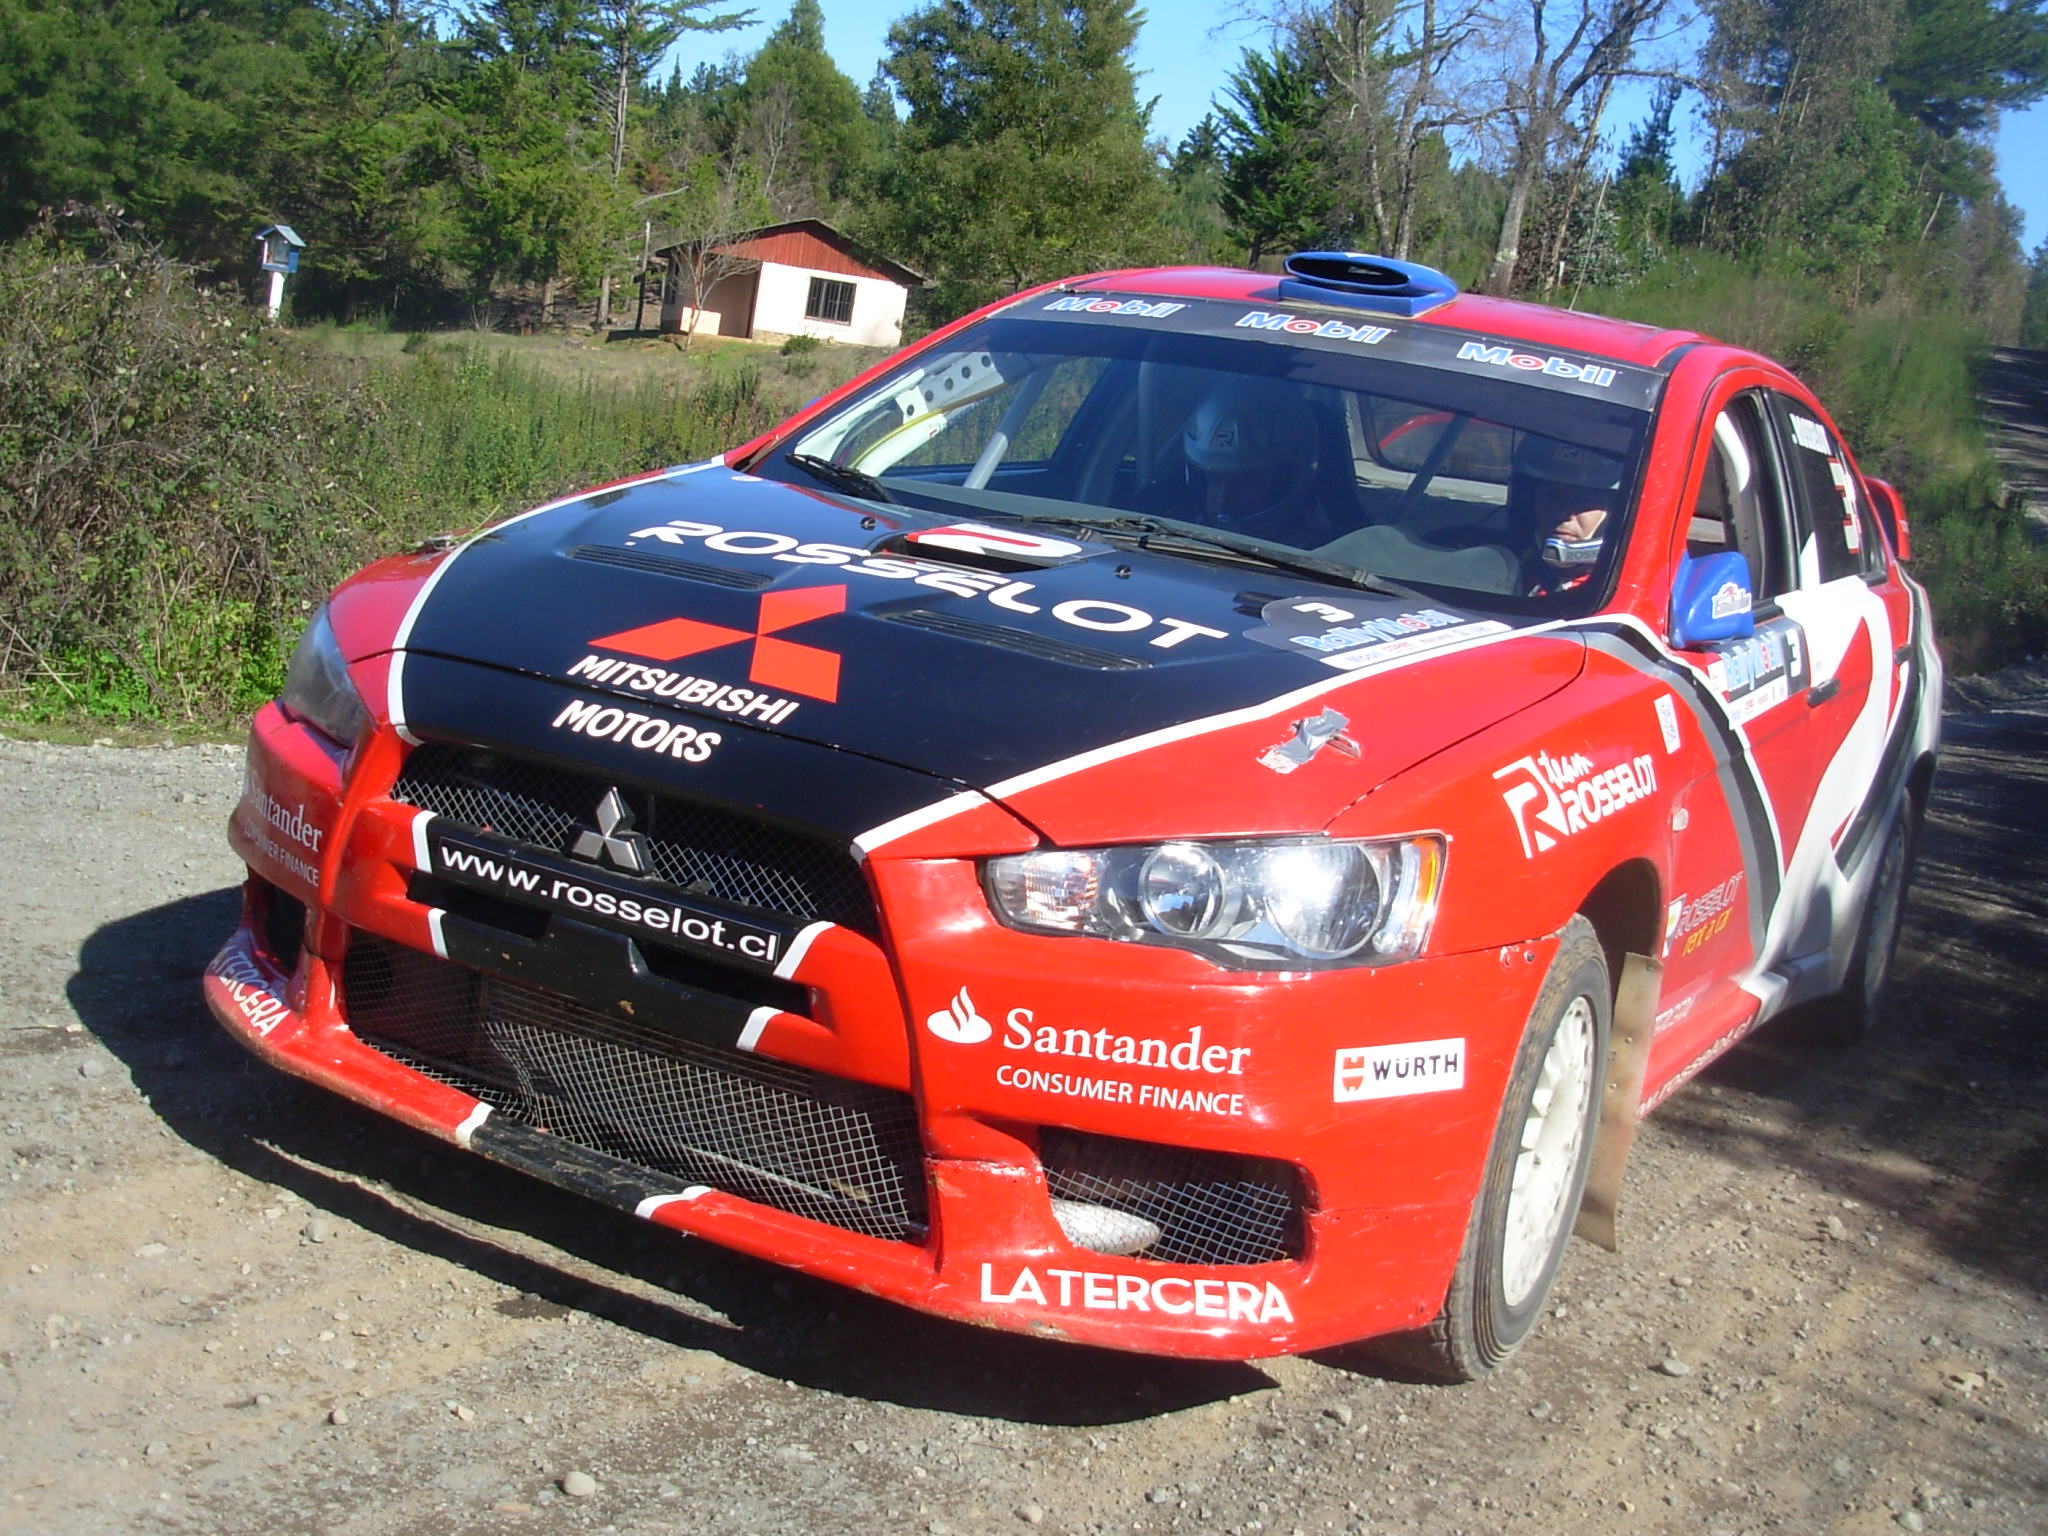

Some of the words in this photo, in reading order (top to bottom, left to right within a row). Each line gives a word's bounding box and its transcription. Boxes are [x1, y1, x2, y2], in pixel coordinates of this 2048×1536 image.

[1043, 295, 1185, 319] Mobil
[1235, 311, 1393, 345] Mobil
[1456, 341, 1617, 388] Mobil
[625, 520, 1229, 649] ROSSELOT
[1292, 602, 1355, 623] 3
[1785, 628, 1801, 678] 3
[566, 655, 800, 725] MITSUBISHI
[552, 700, 721, 763] MOTORS
[249, 769, 323, 853] Santander
[1559, 753, 1657, 834] ROSSELOT
[280, 847, 320, 887] FINANCE
[441, 845, 778, 962] www.rosselot.cl
[1002, 1007, 1252, 1076] Santander
[1372, 1052, 1459, 1081] WÜRTH
[996, 1064, 1134, 1105] CONSUMER
[1138, 1085, 1244, 1116] FINANCE
